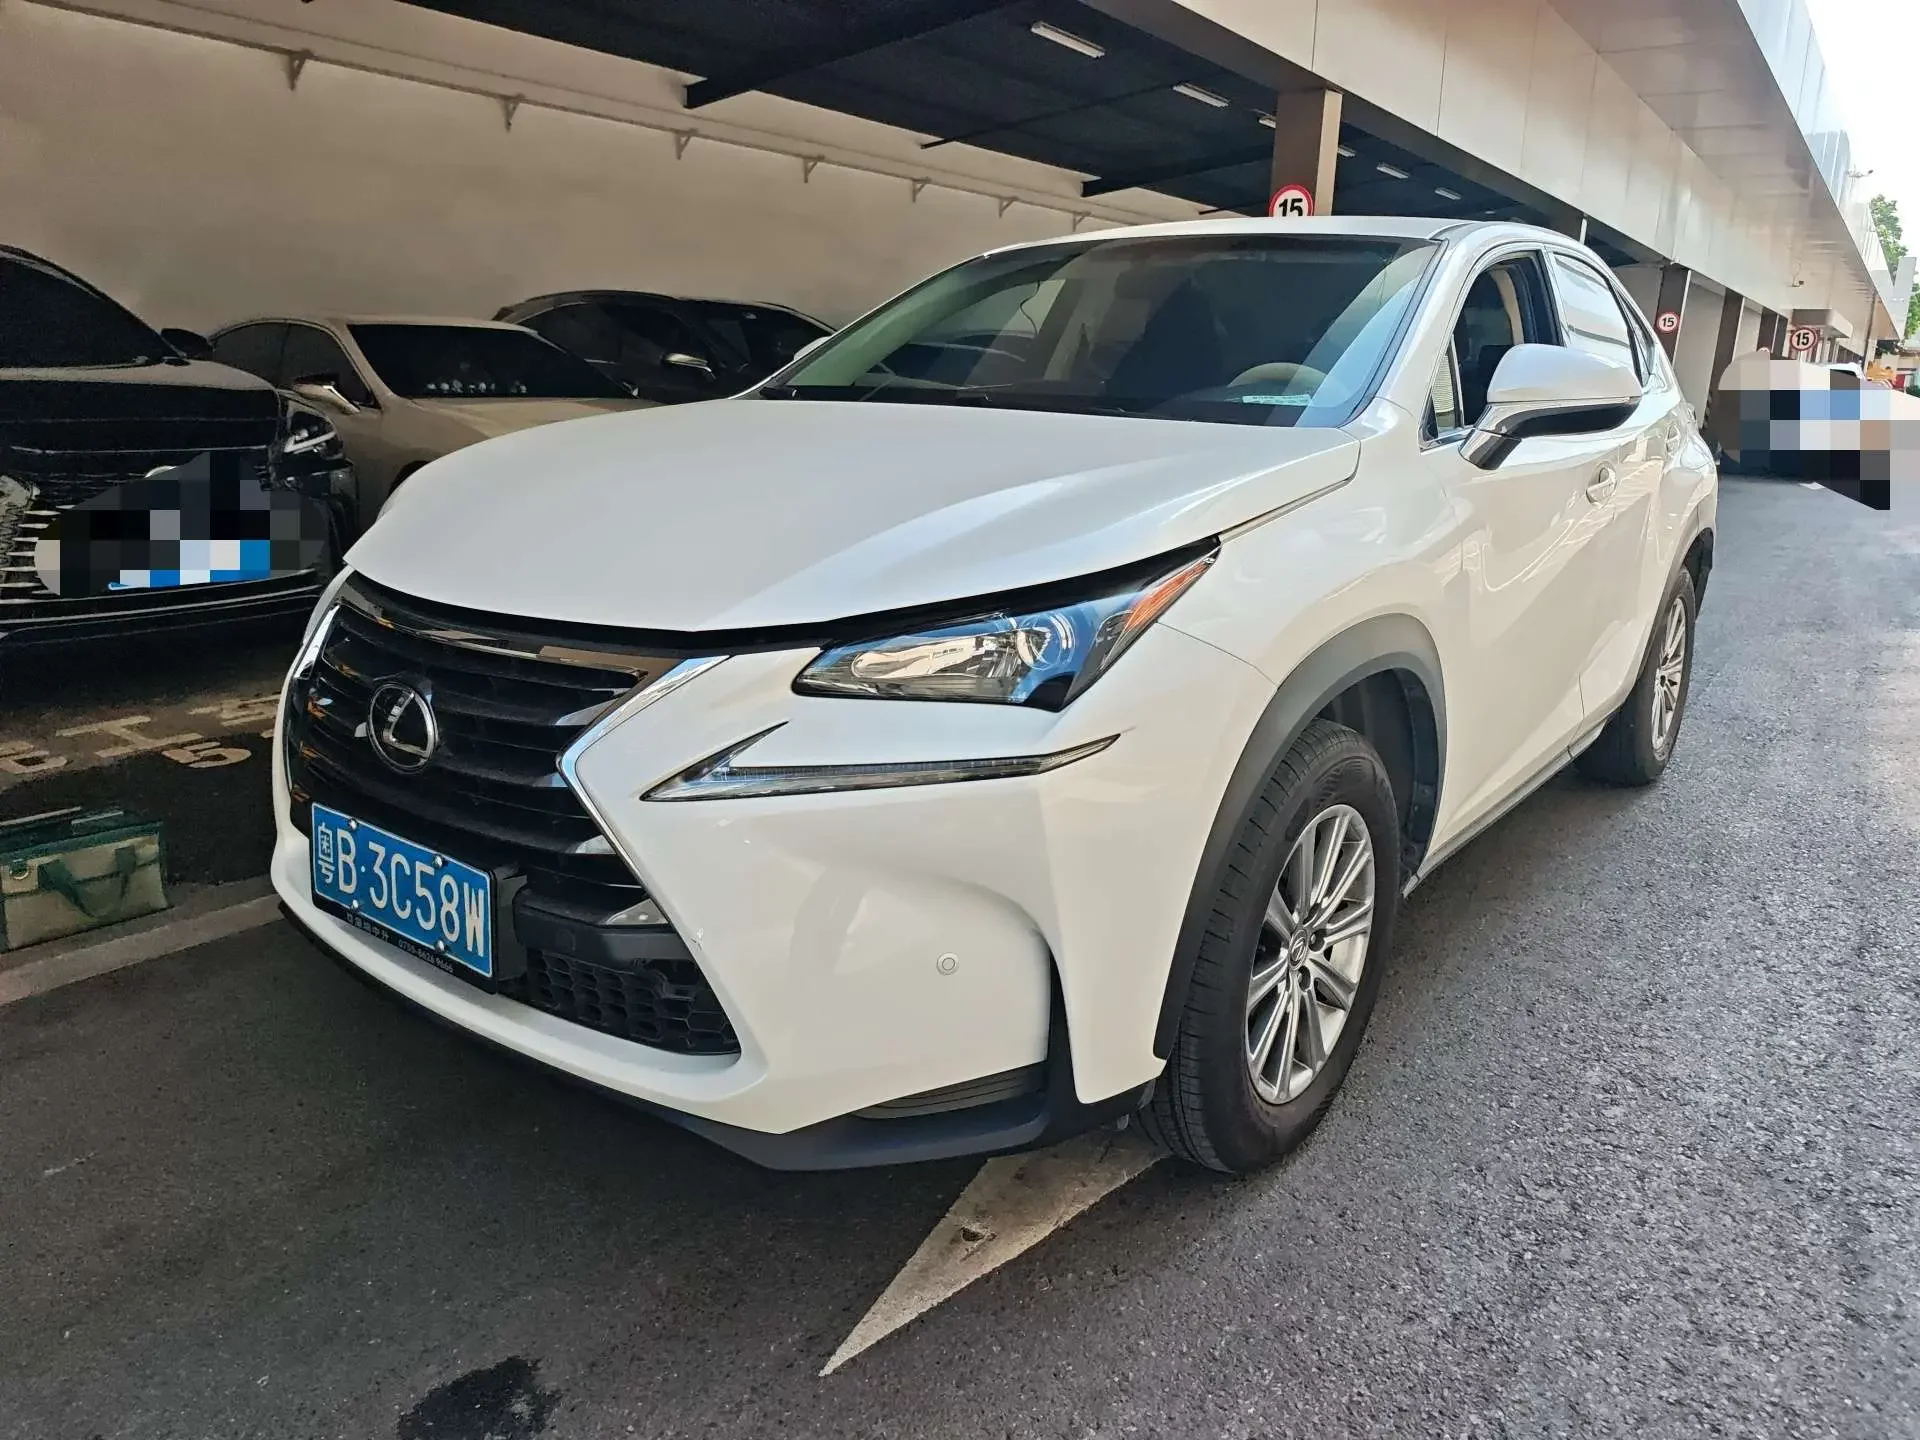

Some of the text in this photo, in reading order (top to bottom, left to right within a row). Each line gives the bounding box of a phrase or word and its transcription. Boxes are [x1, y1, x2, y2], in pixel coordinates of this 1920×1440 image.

[1279, 198, 1304, 217] 15
[1661, 316, 1675, 328] 15
[1795, 332, 1810, 346] 15
